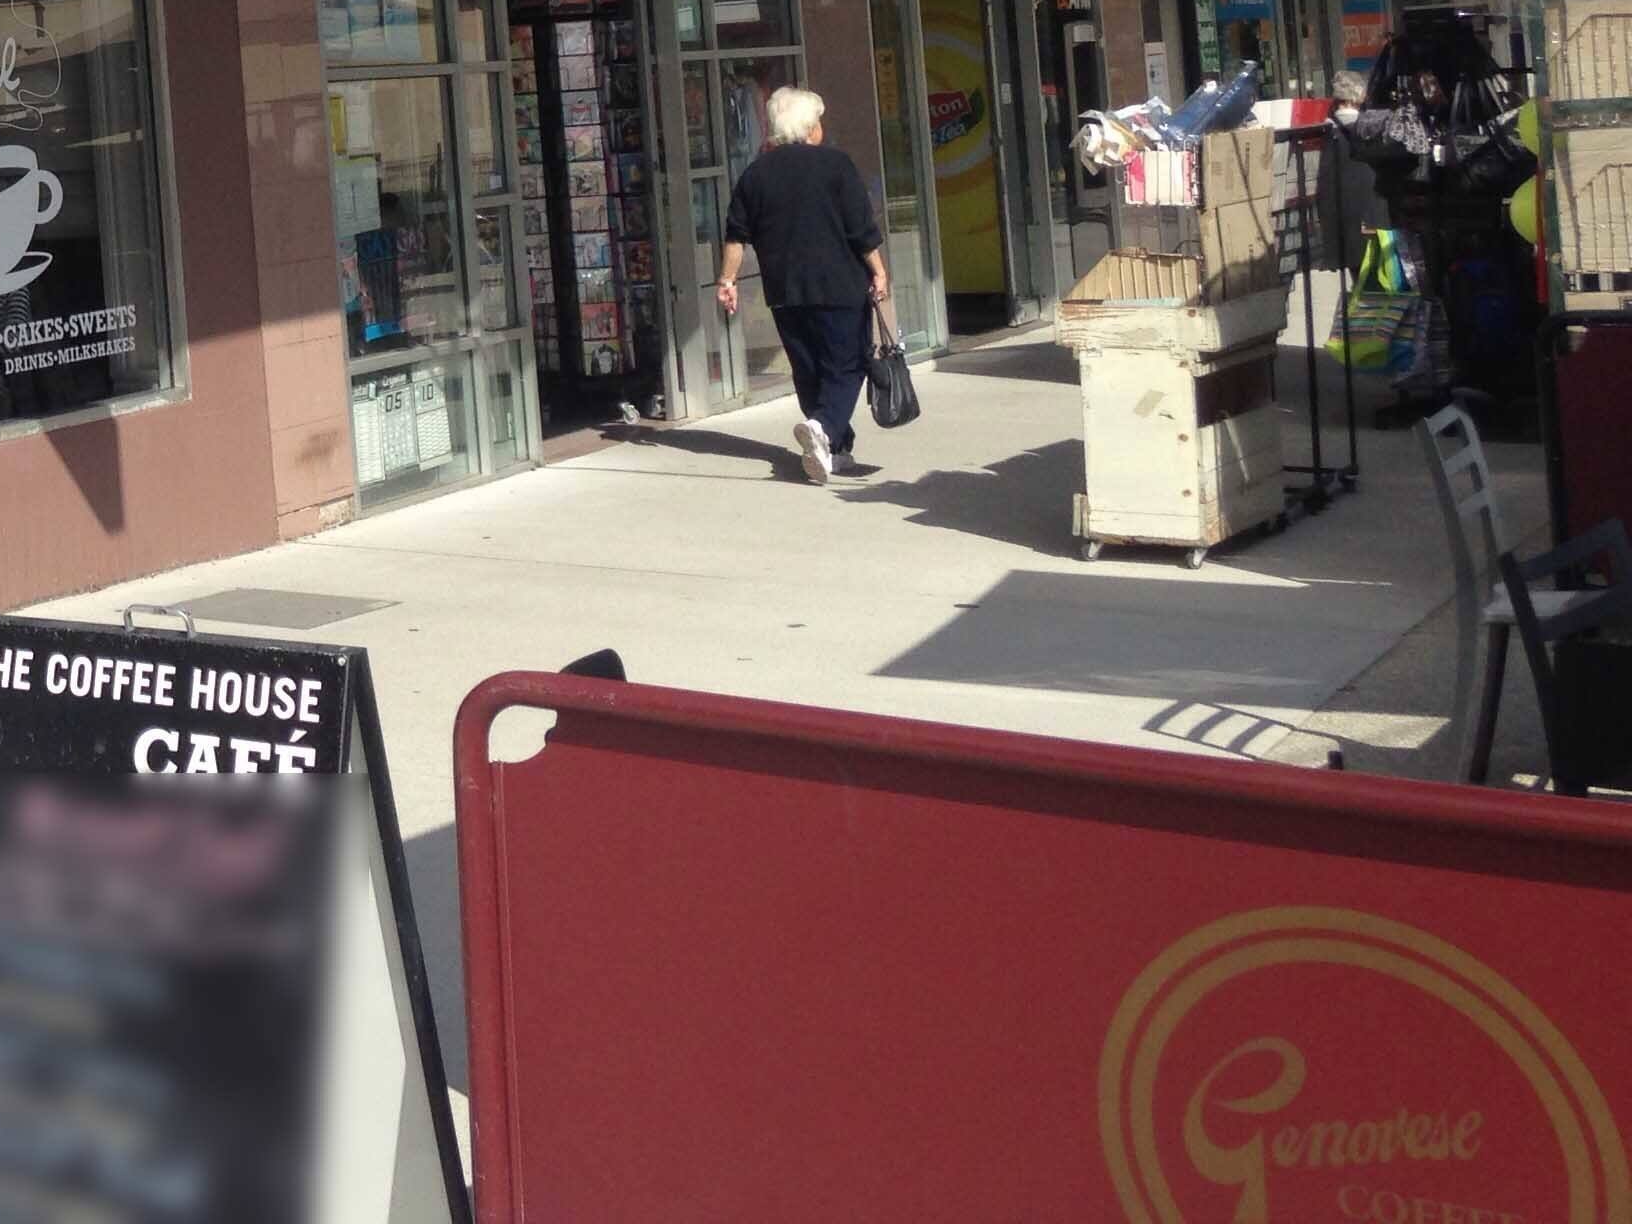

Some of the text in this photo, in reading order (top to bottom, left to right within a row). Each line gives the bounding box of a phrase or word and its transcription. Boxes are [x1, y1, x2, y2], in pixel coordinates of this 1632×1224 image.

[3, 319, 65, 352] CAKES
[68, 304, 137, 338] SWEETS
[5, 353, 55, 376] DRINKS
[58, 337, 137, 365] MILKSHAKES
[46, 653, 176, 707] COFFEE
[191, 668, 322, 723] HOUSE
[1182, 1036, 1485, 1224] Genovese
